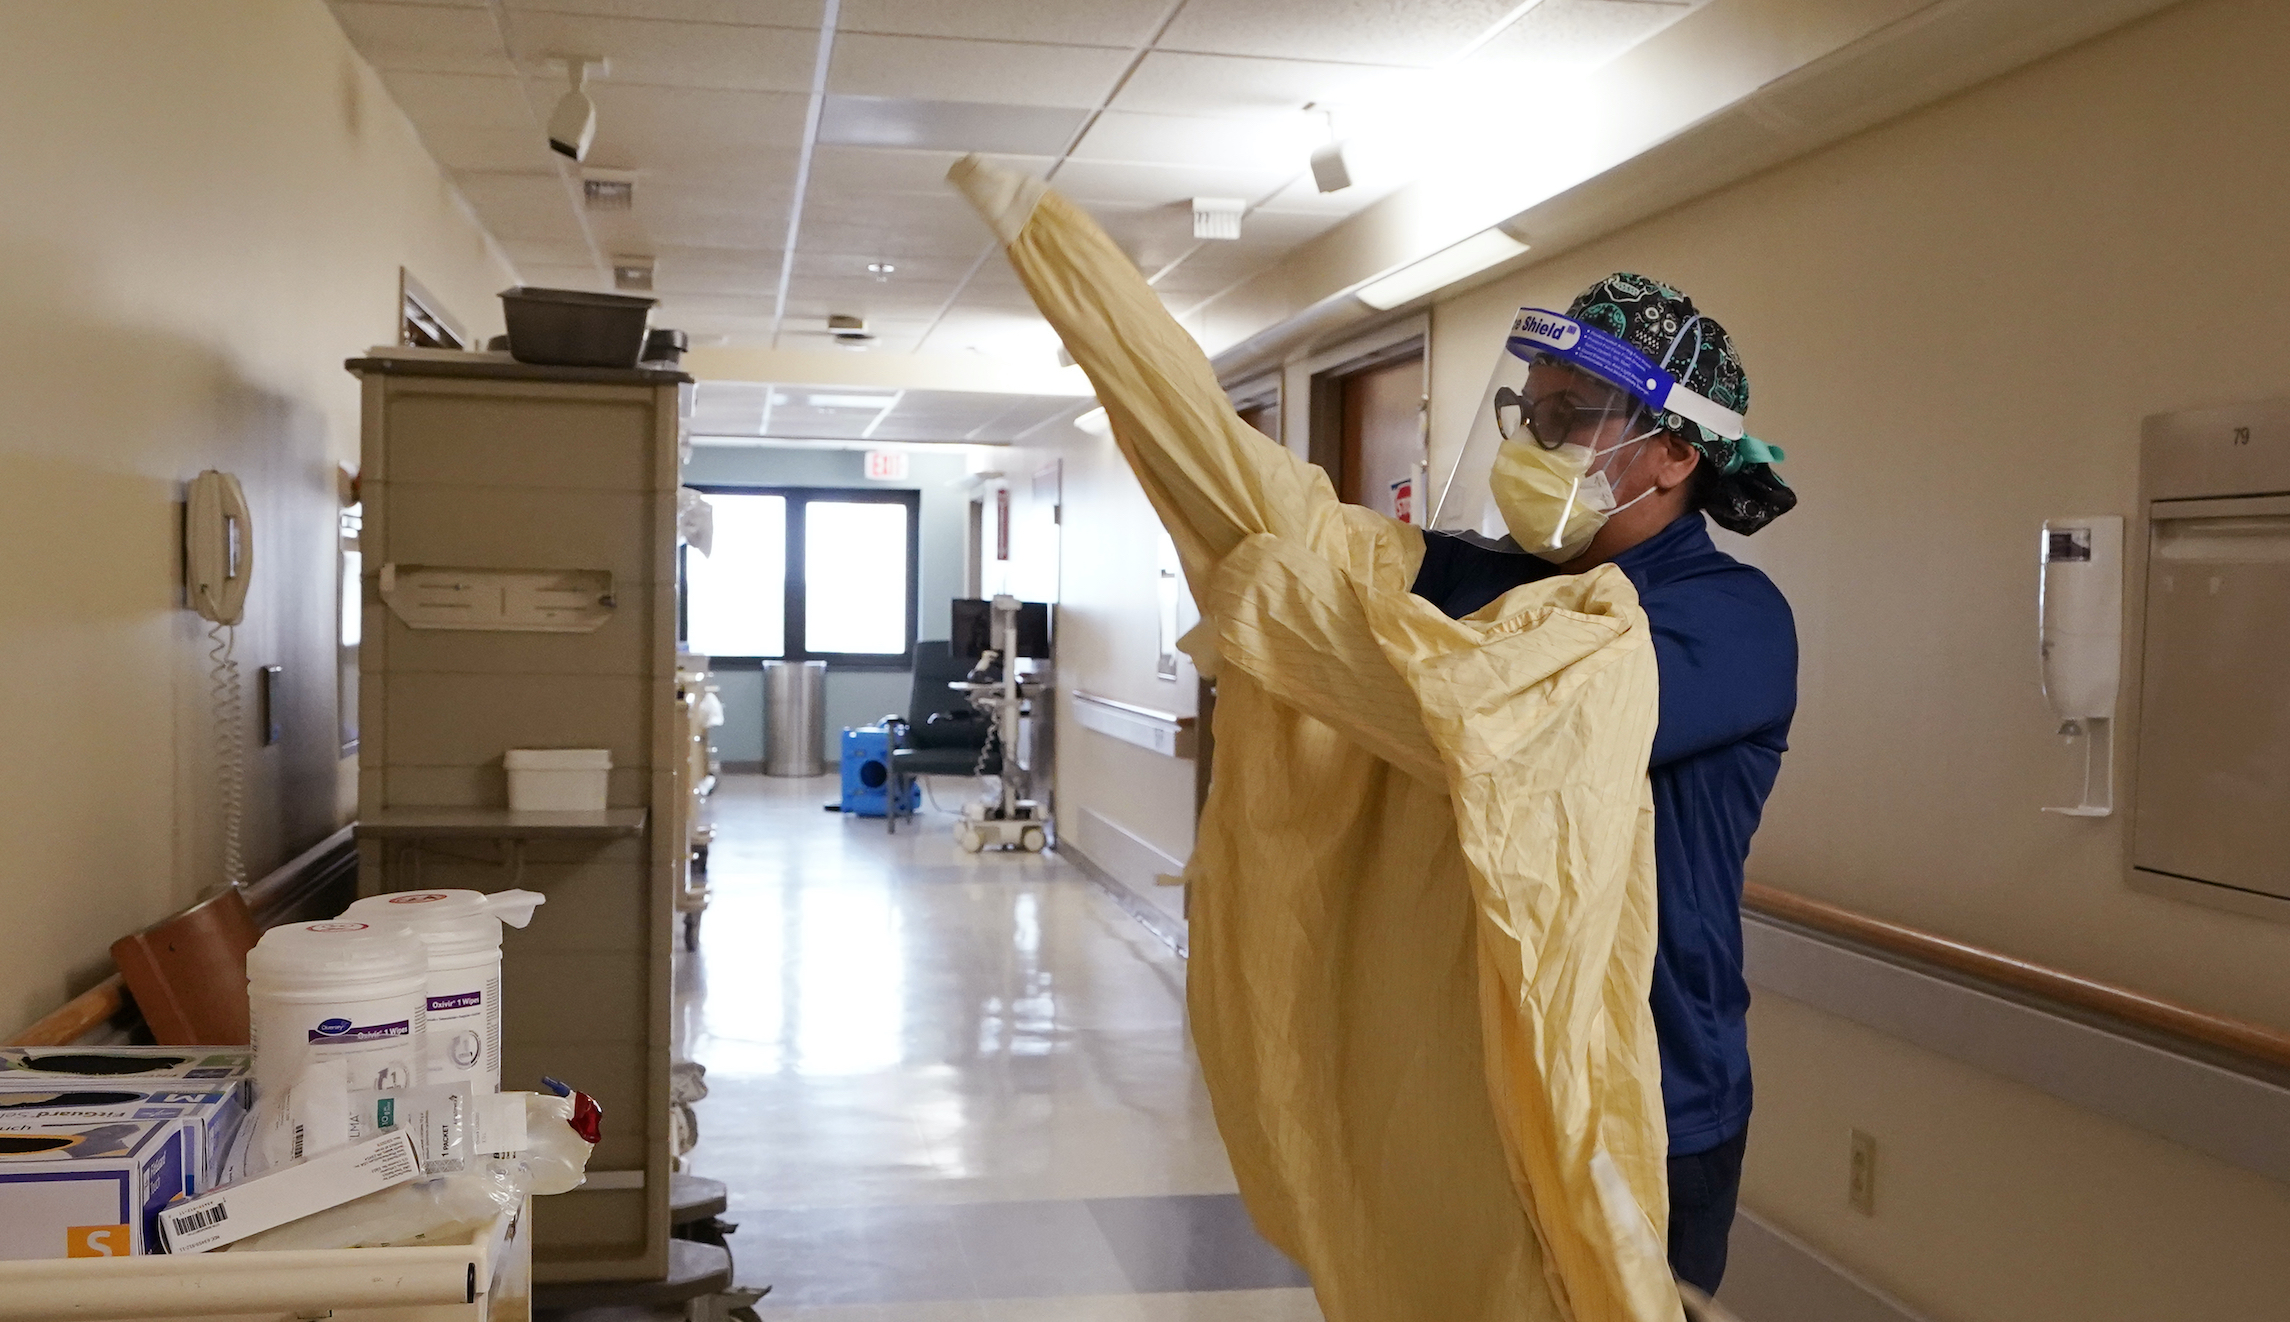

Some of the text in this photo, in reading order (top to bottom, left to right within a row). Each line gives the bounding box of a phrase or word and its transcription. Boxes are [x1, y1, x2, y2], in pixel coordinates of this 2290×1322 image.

[1522, 316, 1566, 340] Shield
[2233, 426, 2250, 445] 79
[349, 1113, 361, 1139] LMA
[86, 1230, 113, 1257] S
